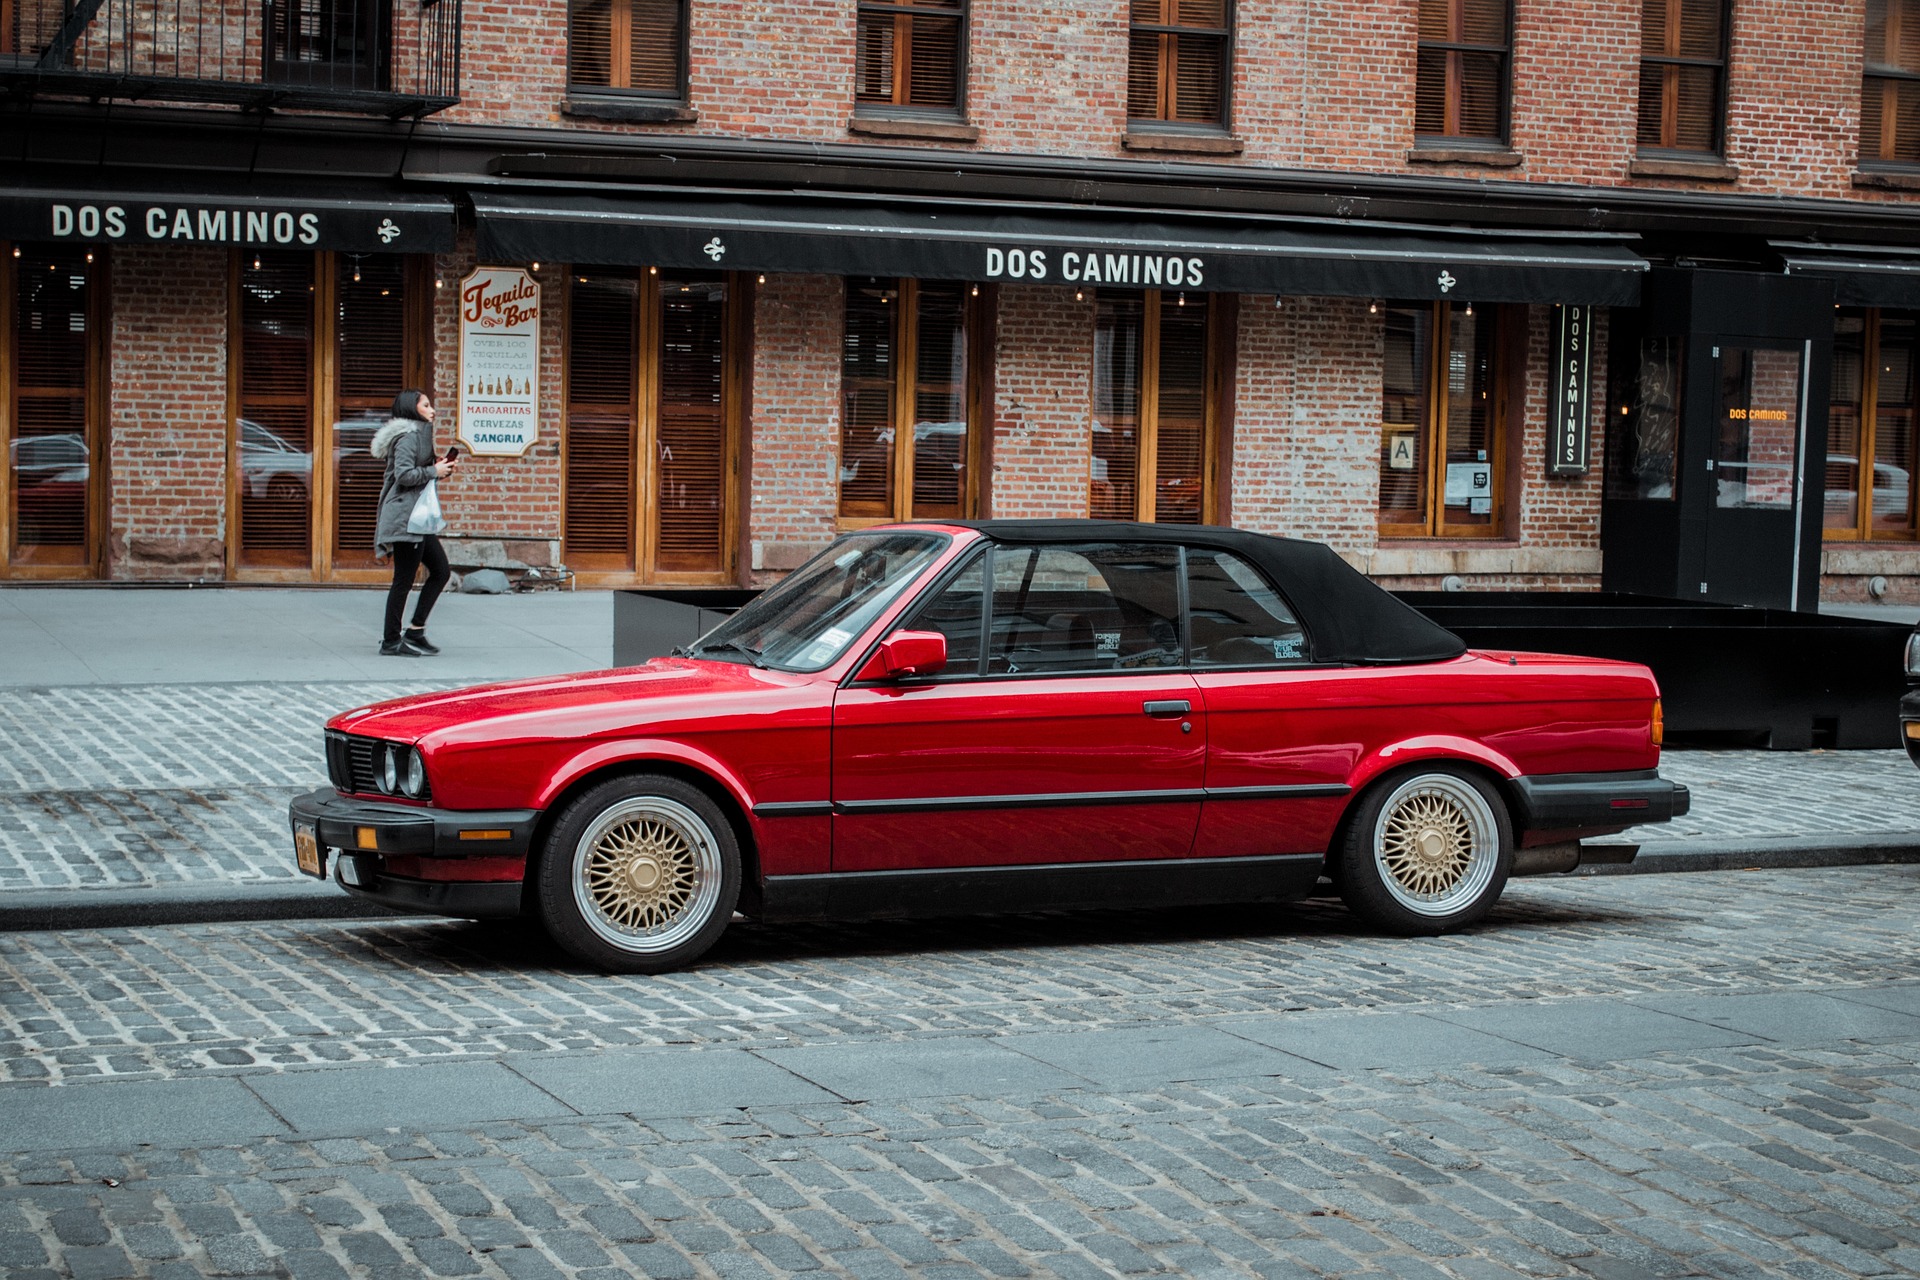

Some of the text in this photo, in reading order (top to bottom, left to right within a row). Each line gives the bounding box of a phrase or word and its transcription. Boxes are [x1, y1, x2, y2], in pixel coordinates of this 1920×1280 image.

[52, 204, 320, 244] DOS CAMINOS
[986, 247, 1204, 286] DOS CAMINOS
[463, 276, 535, 322] Tequila
[503, 304, 538, 328] Bar
[473, 339, 503, 348] OVER
[471, 350, 528, 359] TEQUILAS
[477, 362, 532, 370] MEZCALS
[1566, 307, 1580, 462] DOS CAMINOS
[467, 406, 532, 415] MARGARITAS
[1729, 408, 1788, 420] DOS CAMINOS
[473, 420, 524, 429] CERVEZAS
[474, 433, 524, 443] SANGRIA
[1395, 440, 1409, 459] A
